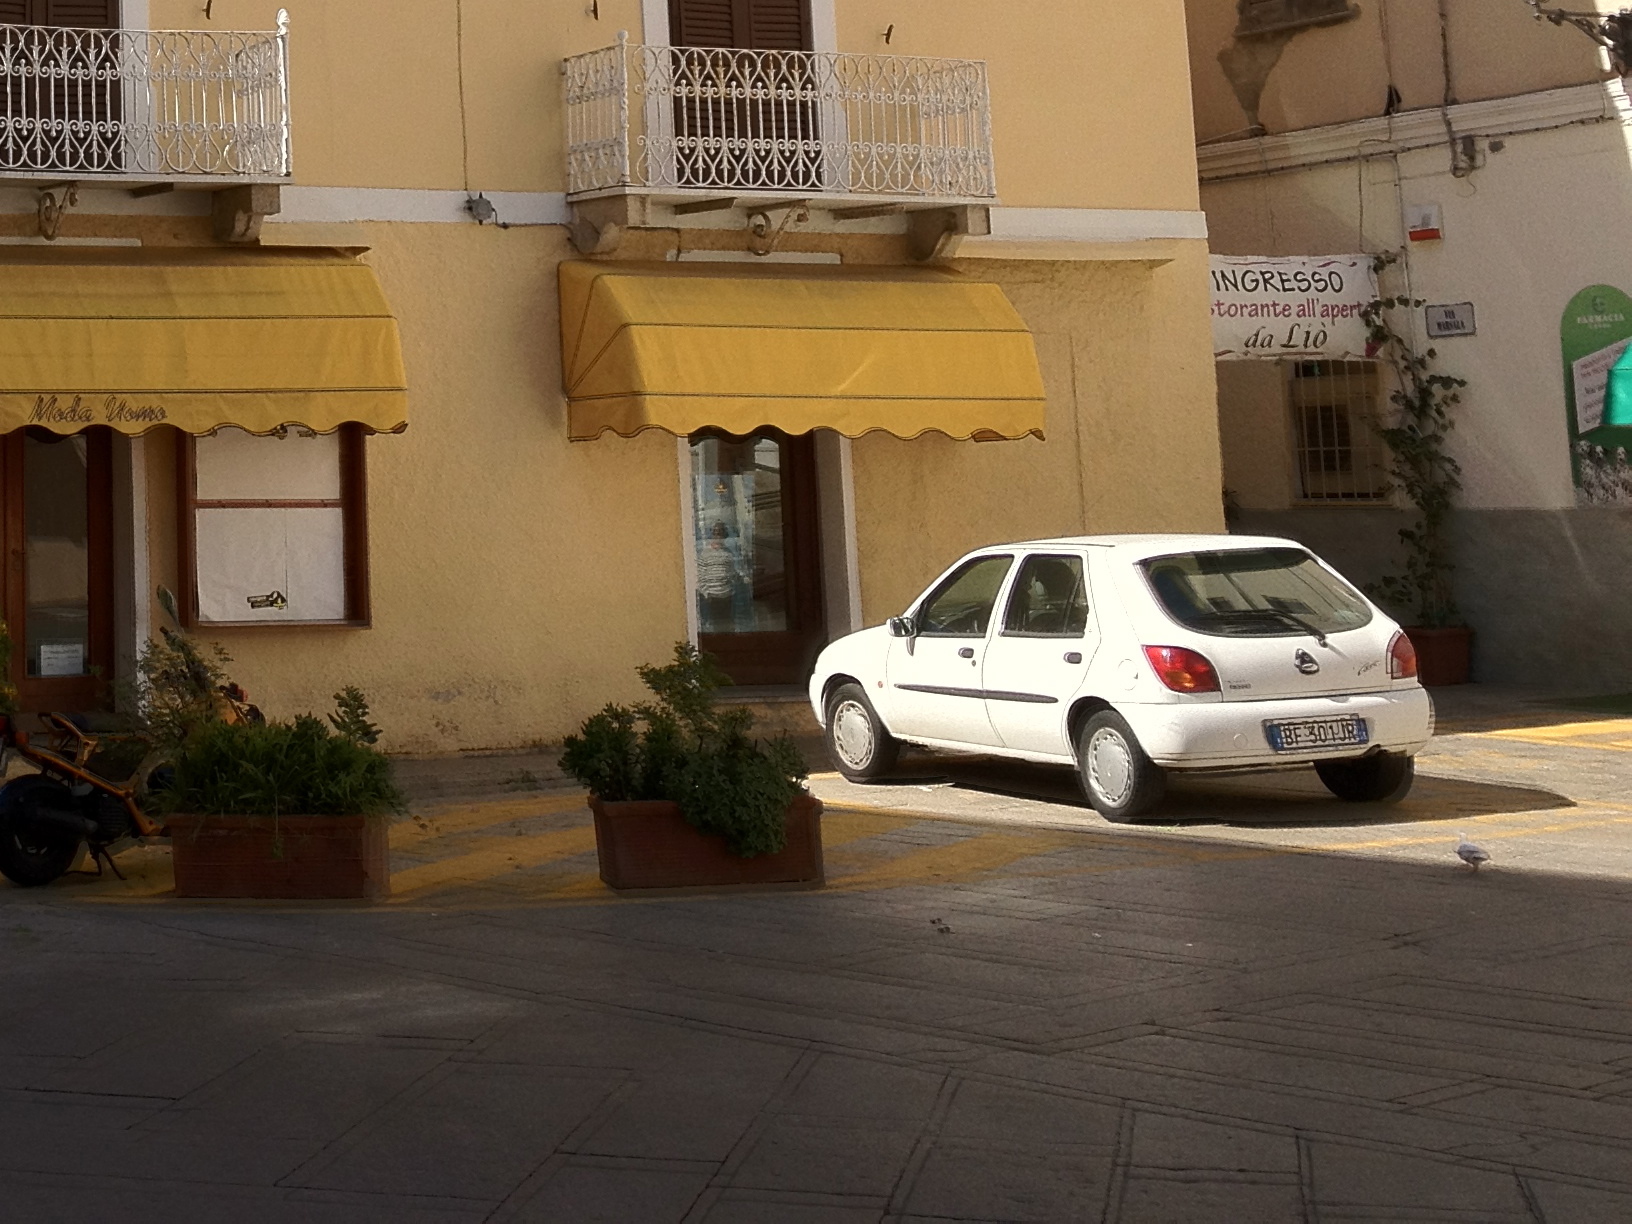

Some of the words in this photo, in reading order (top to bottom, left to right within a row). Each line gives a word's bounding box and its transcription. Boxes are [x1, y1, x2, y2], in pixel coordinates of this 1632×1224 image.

[1211, 269, 1344, 293] INGRESSO
[1244, 326, 1274, 349] da
[1280, 322, 1328, 349] Liò
[28, 394, 94, 423] Moda
[104, 394, 168, 423] Uomo
